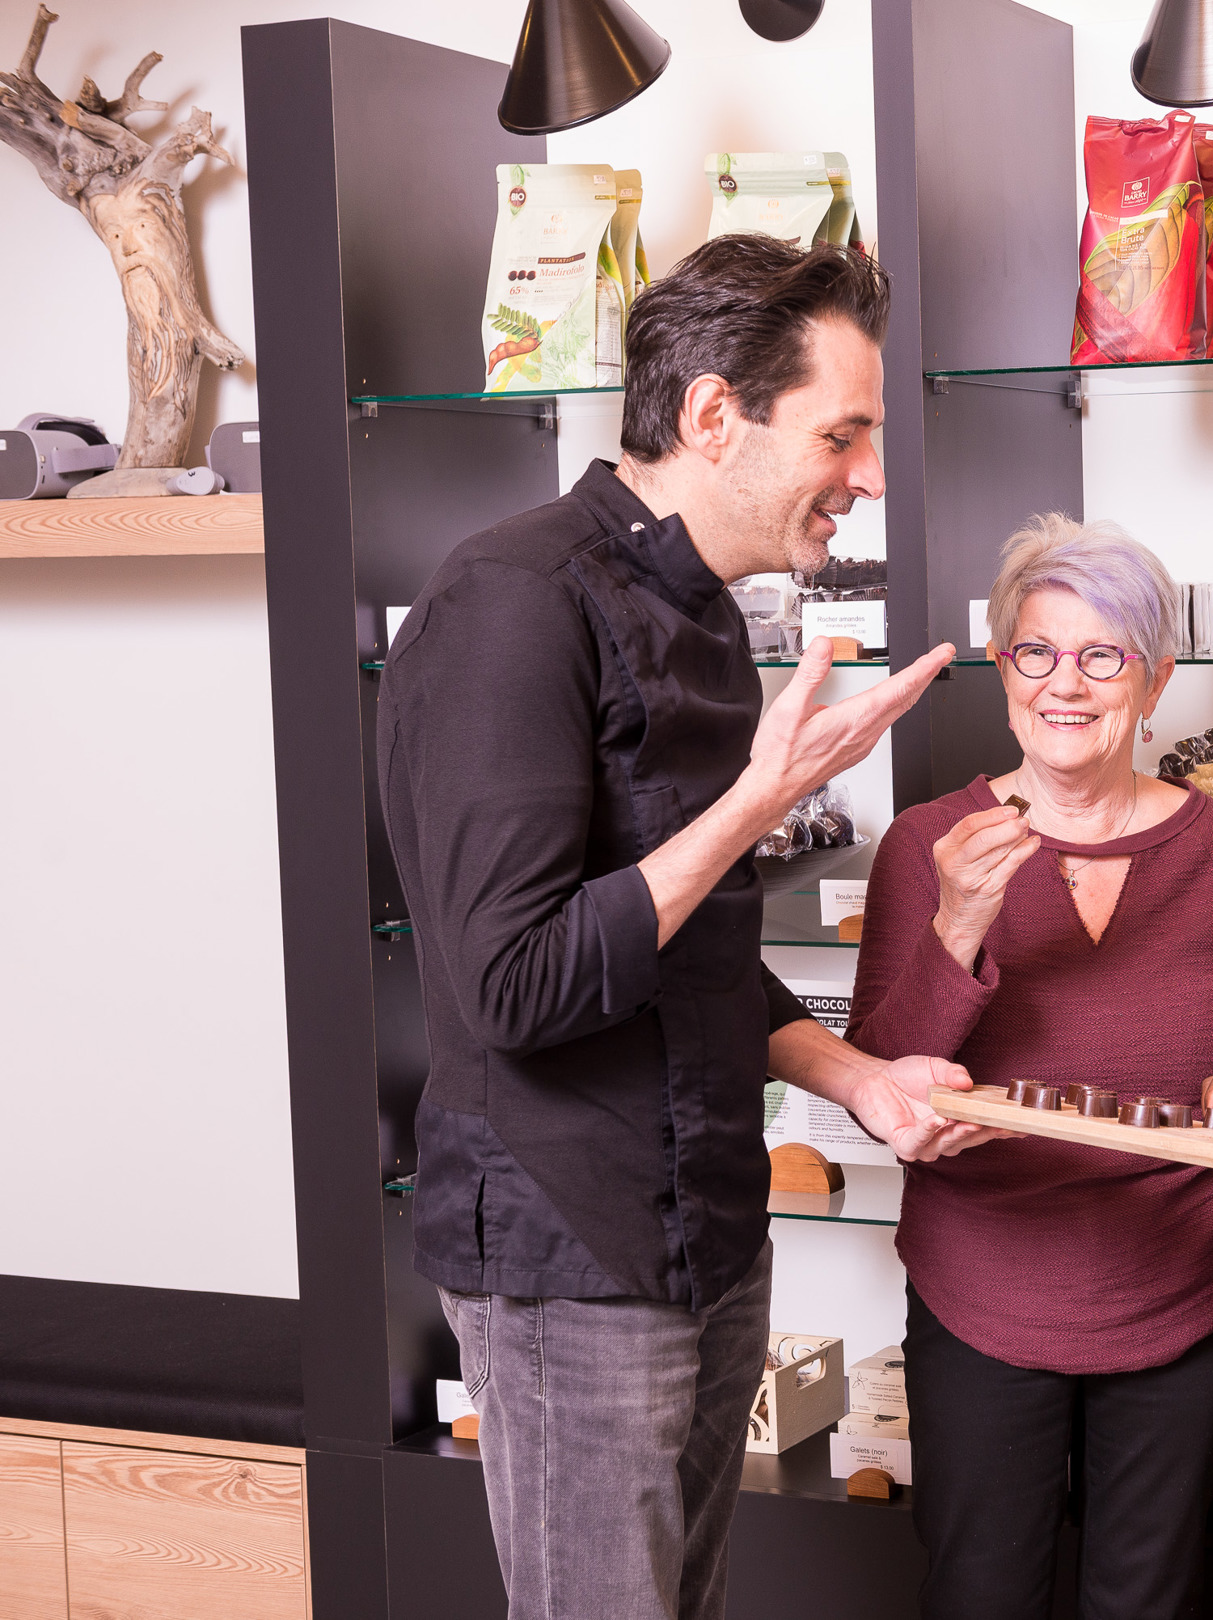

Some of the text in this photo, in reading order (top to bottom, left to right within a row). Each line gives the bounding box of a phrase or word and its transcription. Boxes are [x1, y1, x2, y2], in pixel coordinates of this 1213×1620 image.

[720, 180, 735, 188] BIO
[511, 192, 525, 201] BIO
[1124, 191, 1148, 202] BARRY
[1121, 227, 1145, 237] Extra
[1120, 234, 1145, 244] Brute
[806, 998, 851, 1011] CHOCOL
[849, 1445, 888, 1457] Galets (noir)
